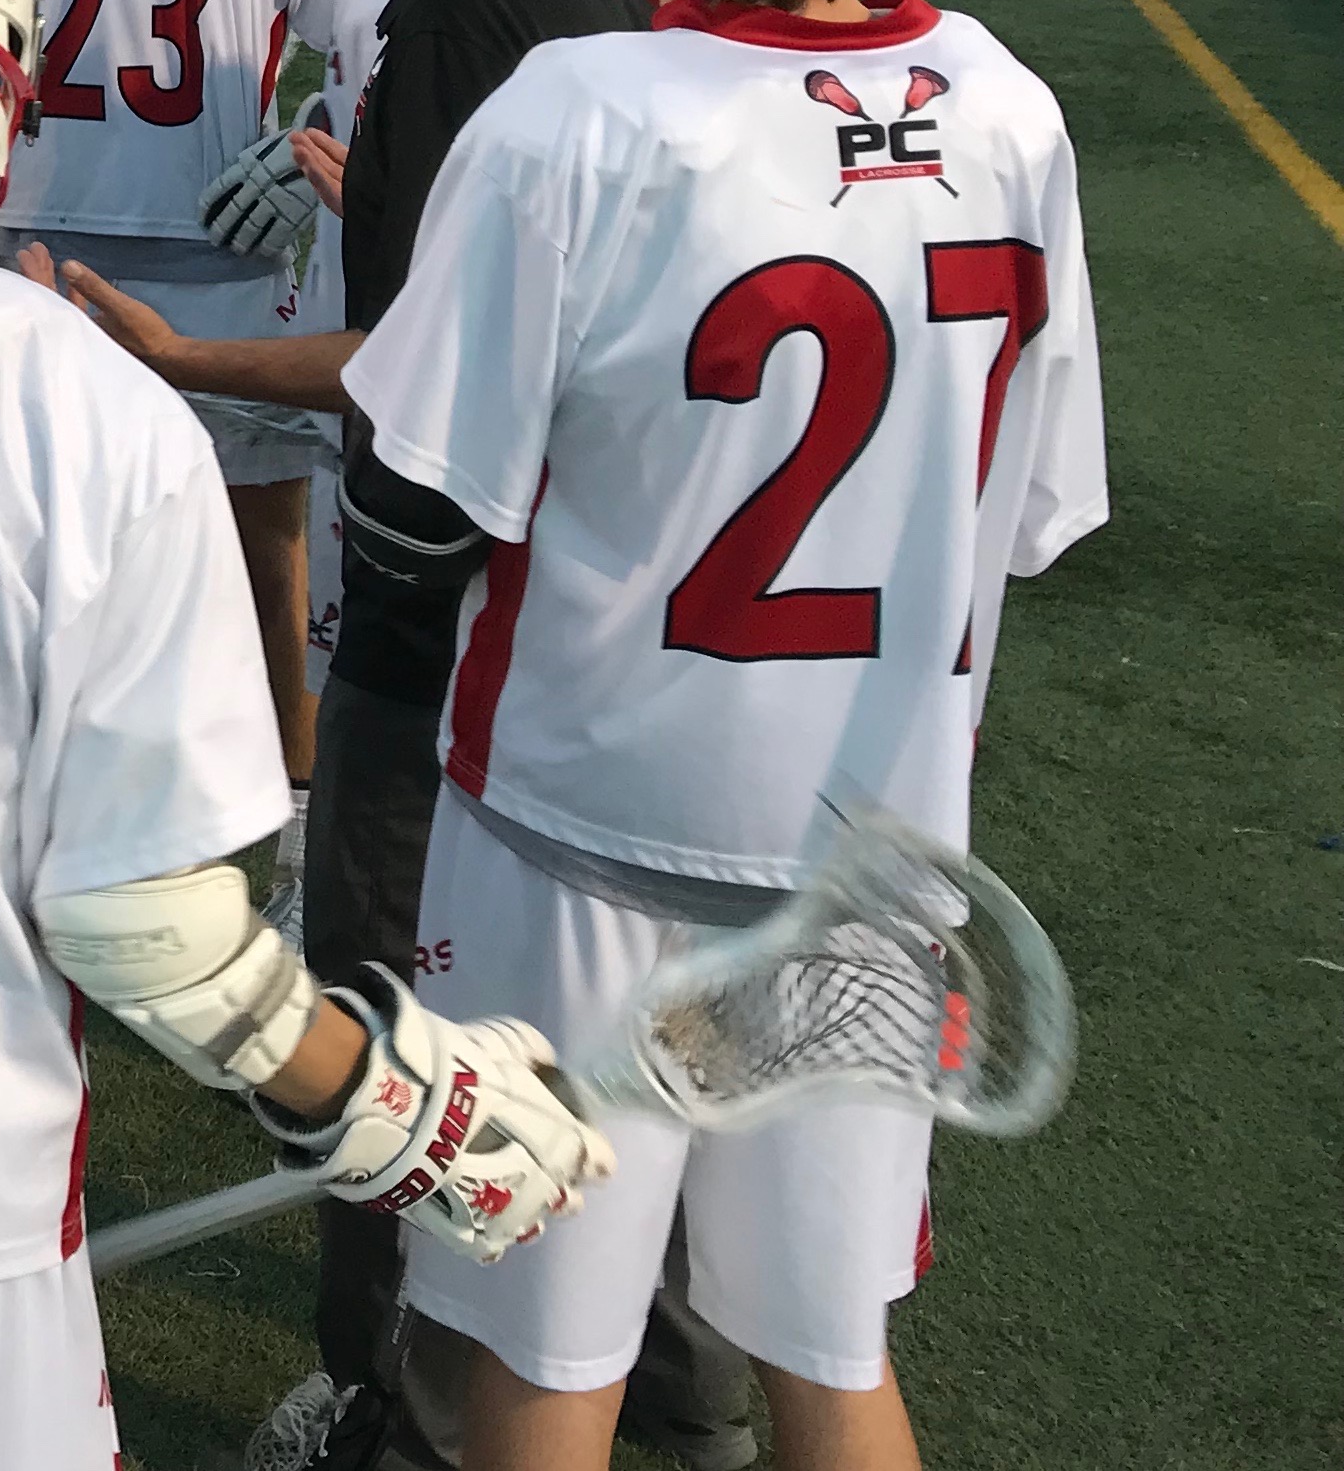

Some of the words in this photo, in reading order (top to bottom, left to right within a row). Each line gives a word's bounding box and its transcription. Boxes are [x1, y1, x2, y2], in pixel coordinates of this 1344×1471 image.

[835, 119, 942, 168] PC
[858, 166, 927, 179] LACROSSE
[663, 237, 1050, 676] 27
